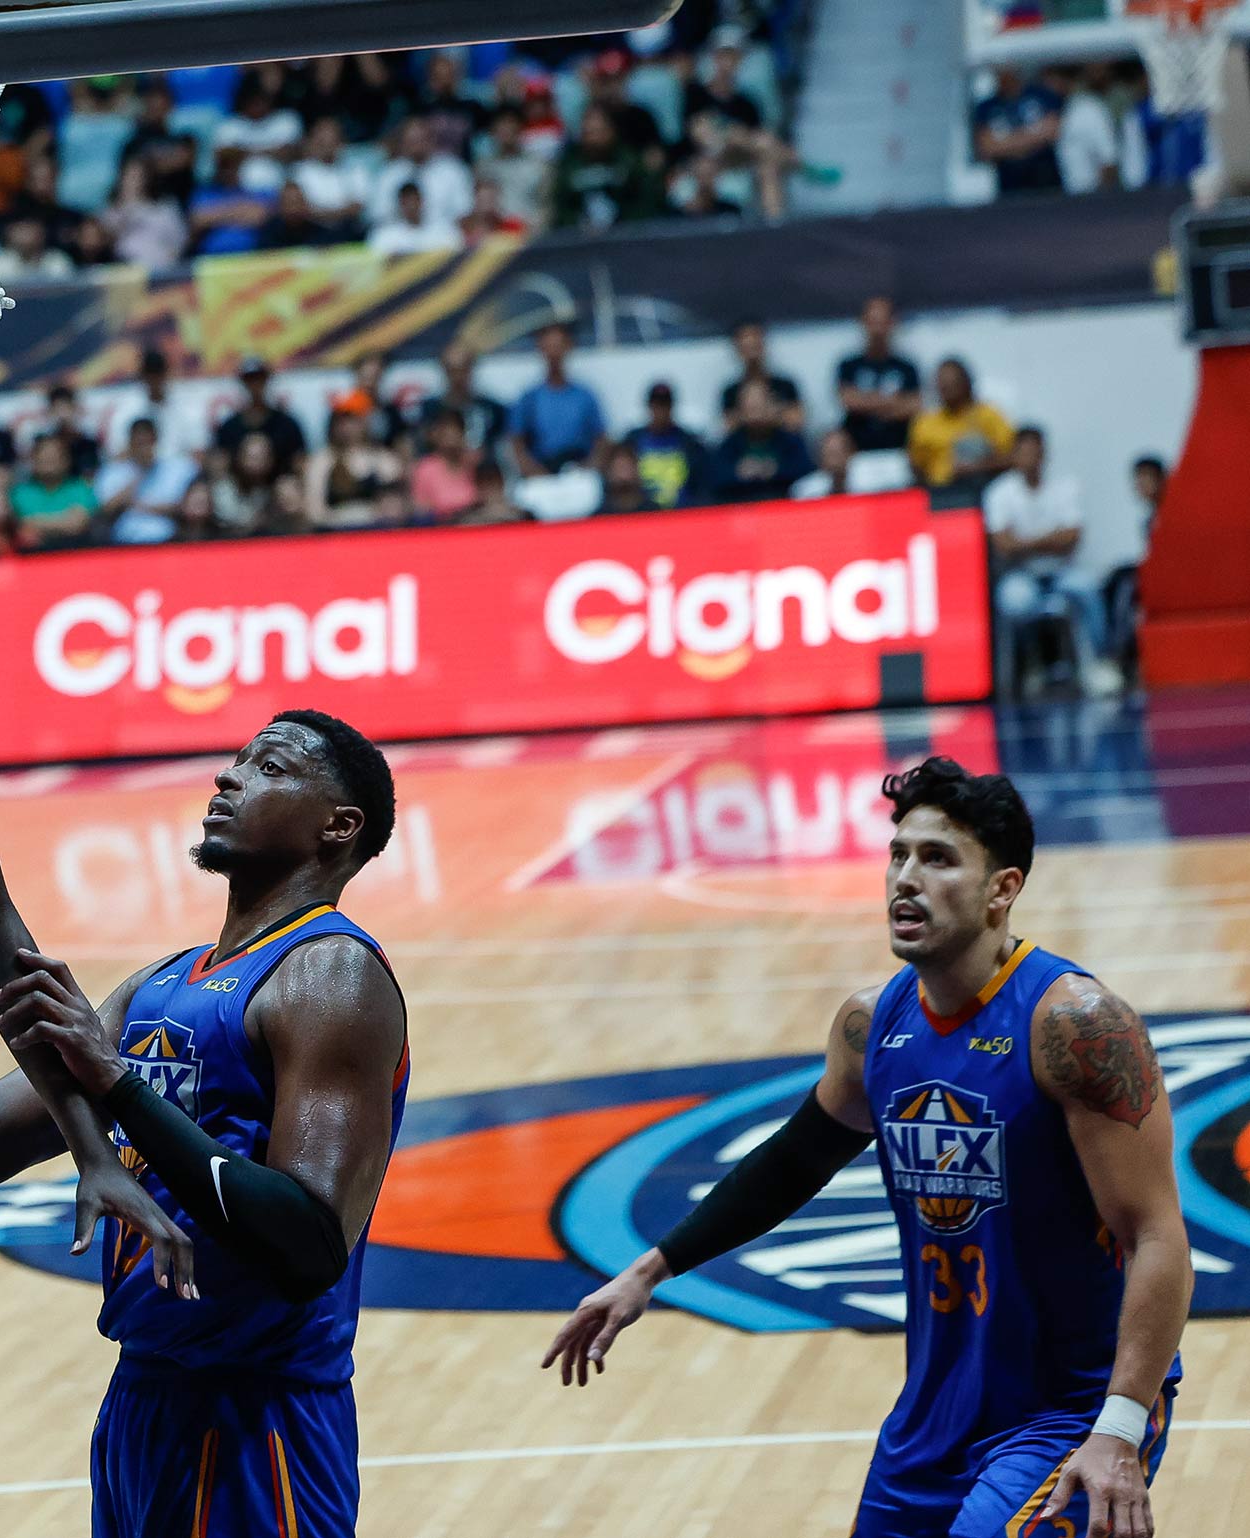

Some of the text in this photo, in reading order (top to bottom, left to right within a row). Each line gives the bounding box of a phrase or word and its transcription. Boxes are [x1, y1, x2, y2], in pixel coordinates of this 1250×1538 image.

[33, 573, 419, 714] Cignal
[544, 532, 940, 681] Cignal
[887, 1124, 997, 1175] NLEX
[921, 1244, 989, 1317] 33
